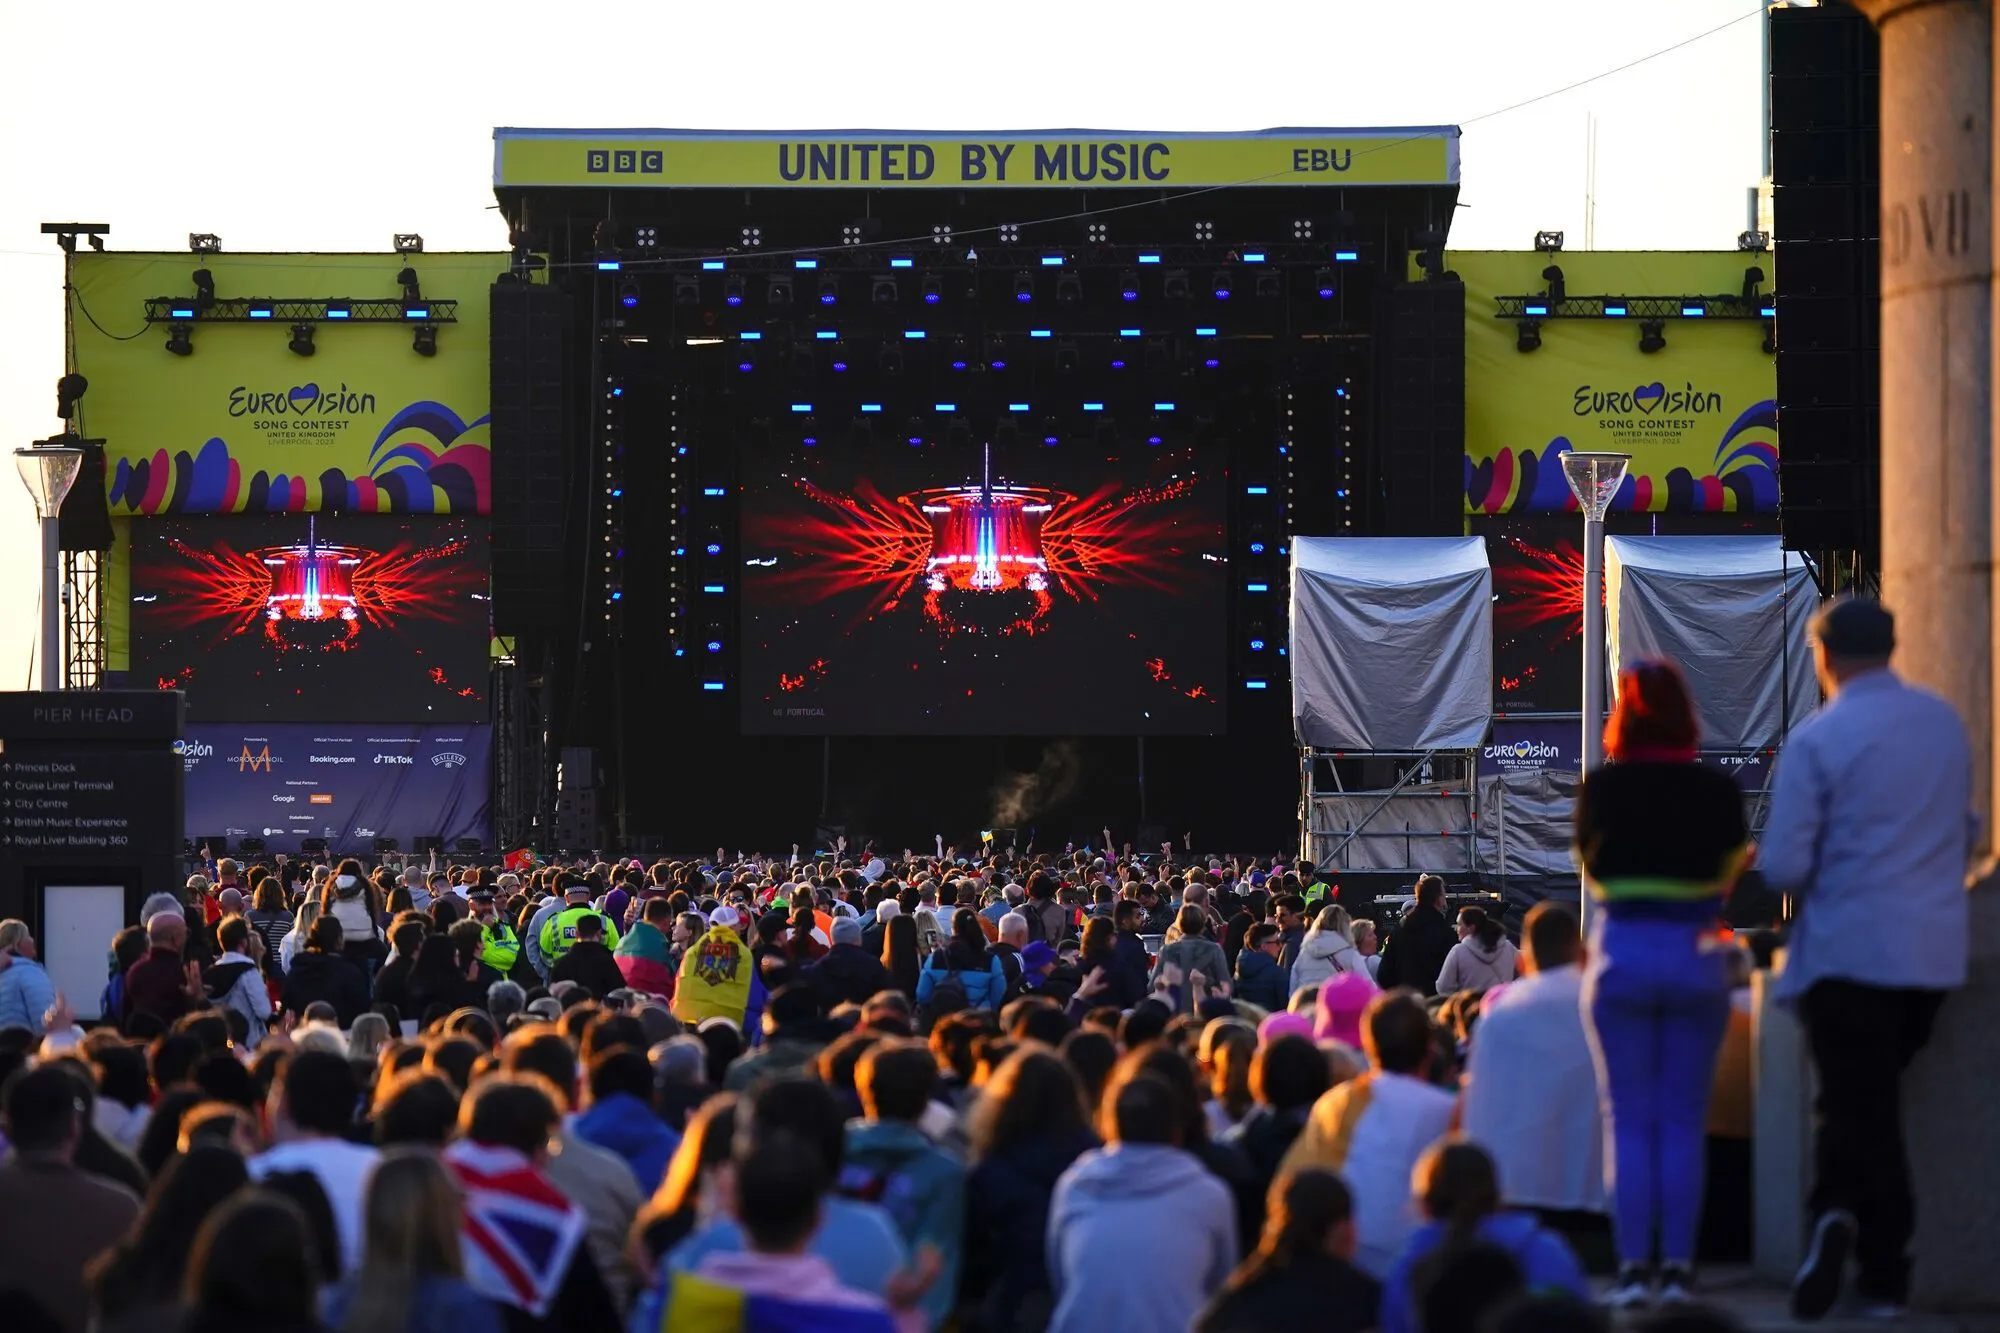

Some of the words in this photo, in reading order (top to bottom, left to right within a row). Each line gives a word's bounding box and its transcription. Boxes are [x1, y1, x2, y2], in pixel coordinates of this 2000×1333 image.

[589, 152, 661, 171] BBC
[778, 143, 935, 181] UNITED
[961, 143, 1016, 181] BY
[1034, 143, 1171, 181] MUSIC
[1293, 148, 1351, 171] EBU
[254, 420, 288, 430] SONG
[293, 420, 350, 430] CONTEST
[1600, 420, 1634, 429] SONG
[1638, 420, 1695, 429] CONTEST
[33, 708, 72, 722] PIER
[81, 708, 134, 722] HEAD
[310, 755, 356, 764] Booking.com
[383, 756, 414, 764] TikTok
[434, 753, 463, 764] BAILEYS
[14, 763, 48, 772] Princes
[52, 763, 76, 772] Dock
[14, 781, 44, 790] Cruise
[47, 781, 70, 790] Liner
[74, 780, 114, 790] Terminal
[272, 795, 295, 803] Google
[14, 800, 34, 810] City
[36, 800, 68, 808] Centre
[14, 818, 44, 827] British
[46, 818, 72, 827] Music
[76, 818, 128, 828] Experience
[14, 836, 40, 846] Royal
[43, 836, 64, 845] Liver
[68, 836, 107, 846] Building
[108, 836, 128, 845] 360
